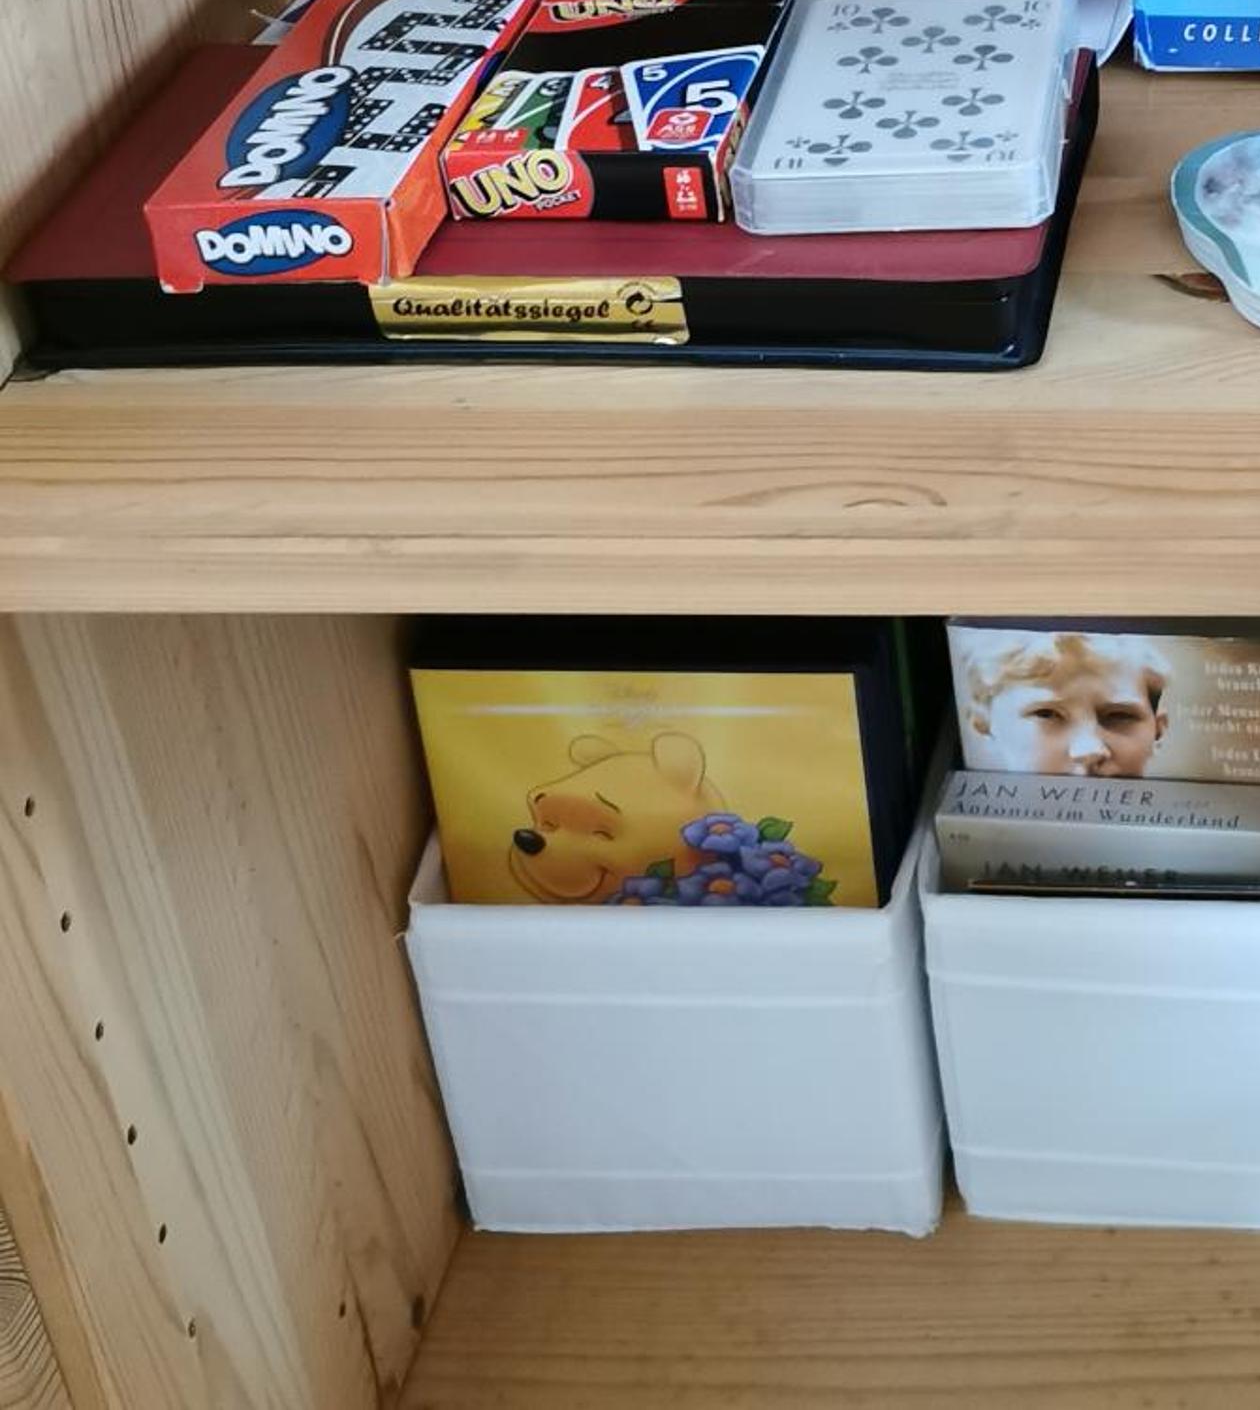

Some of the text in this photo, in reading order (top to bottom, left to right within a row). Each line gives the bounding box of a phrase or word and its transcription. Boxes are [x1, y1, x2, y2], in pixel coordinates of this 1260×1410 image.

[641, 65, 668, 83] 5
[684, 79, 739, 113] 5
[216, 63, 360, 189] DOMINO
[450, 148, 572, 217] UNO
[194, 223, 354, 264] DOMINO
[391, 296, 610, 322] Qualitätssiegel
[954, 780, 1018, 800] JAN
[1039, 784, 1156, 807] WEILER
[950, 800, 1242, 831] Antonio im Wunderland
